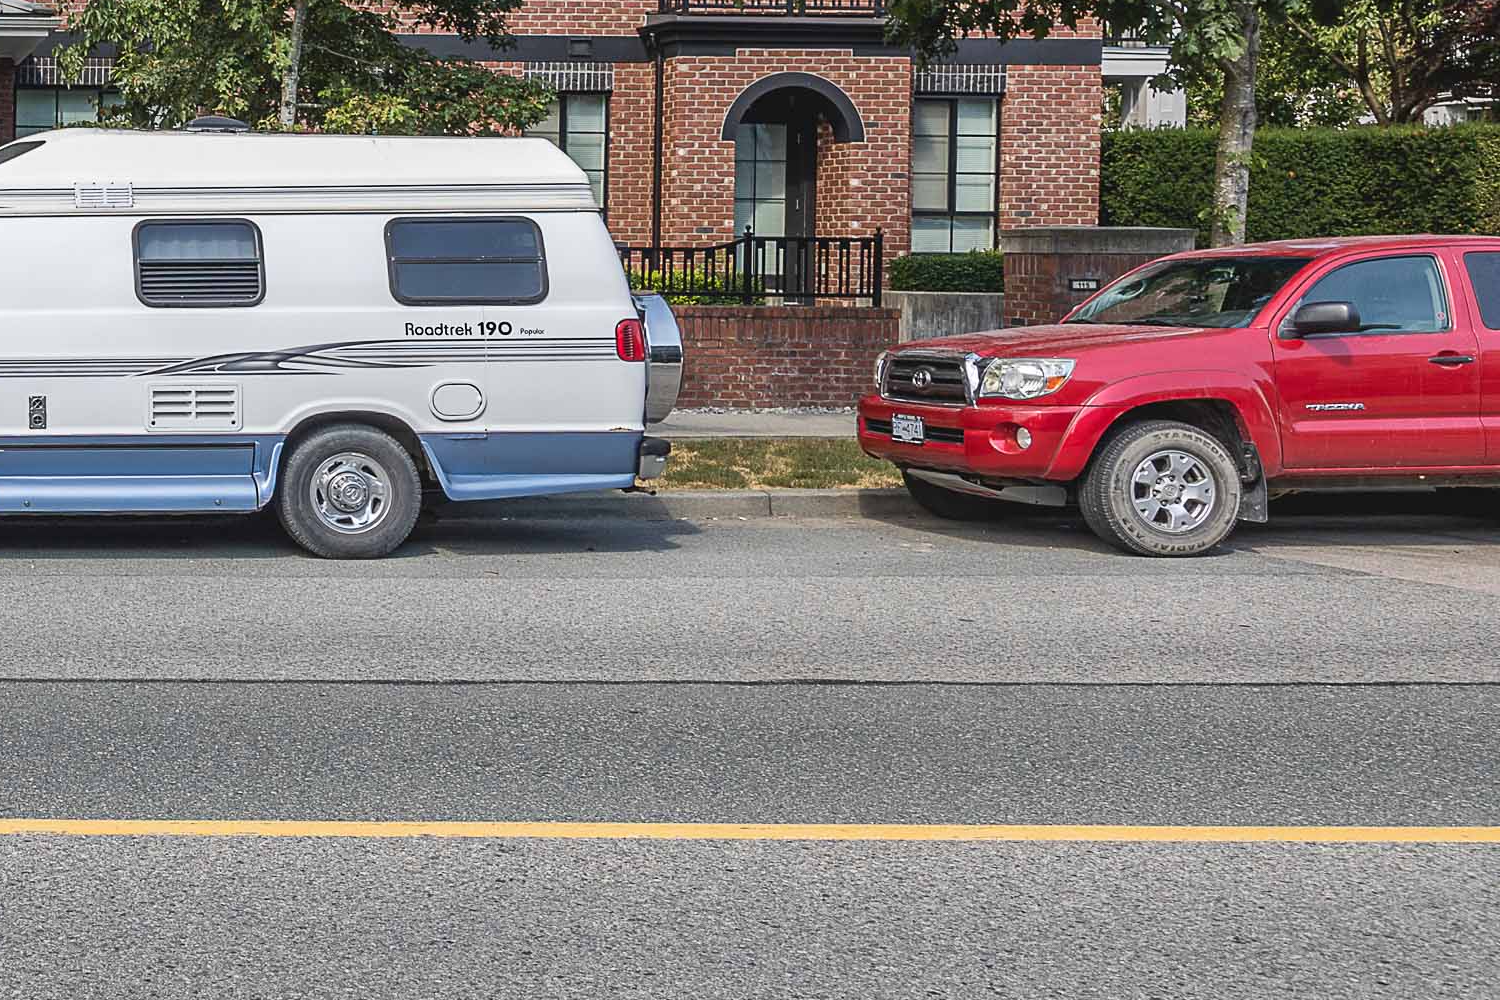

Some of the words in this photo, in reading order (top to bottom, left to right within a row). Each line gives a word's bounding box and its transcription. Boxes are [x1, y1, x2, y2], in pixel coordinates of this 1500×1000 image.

[404, 321, 473, 336] Roadtrek
[477, 320, 513, 336] 190
[519, 327, 545, 336] Popular
